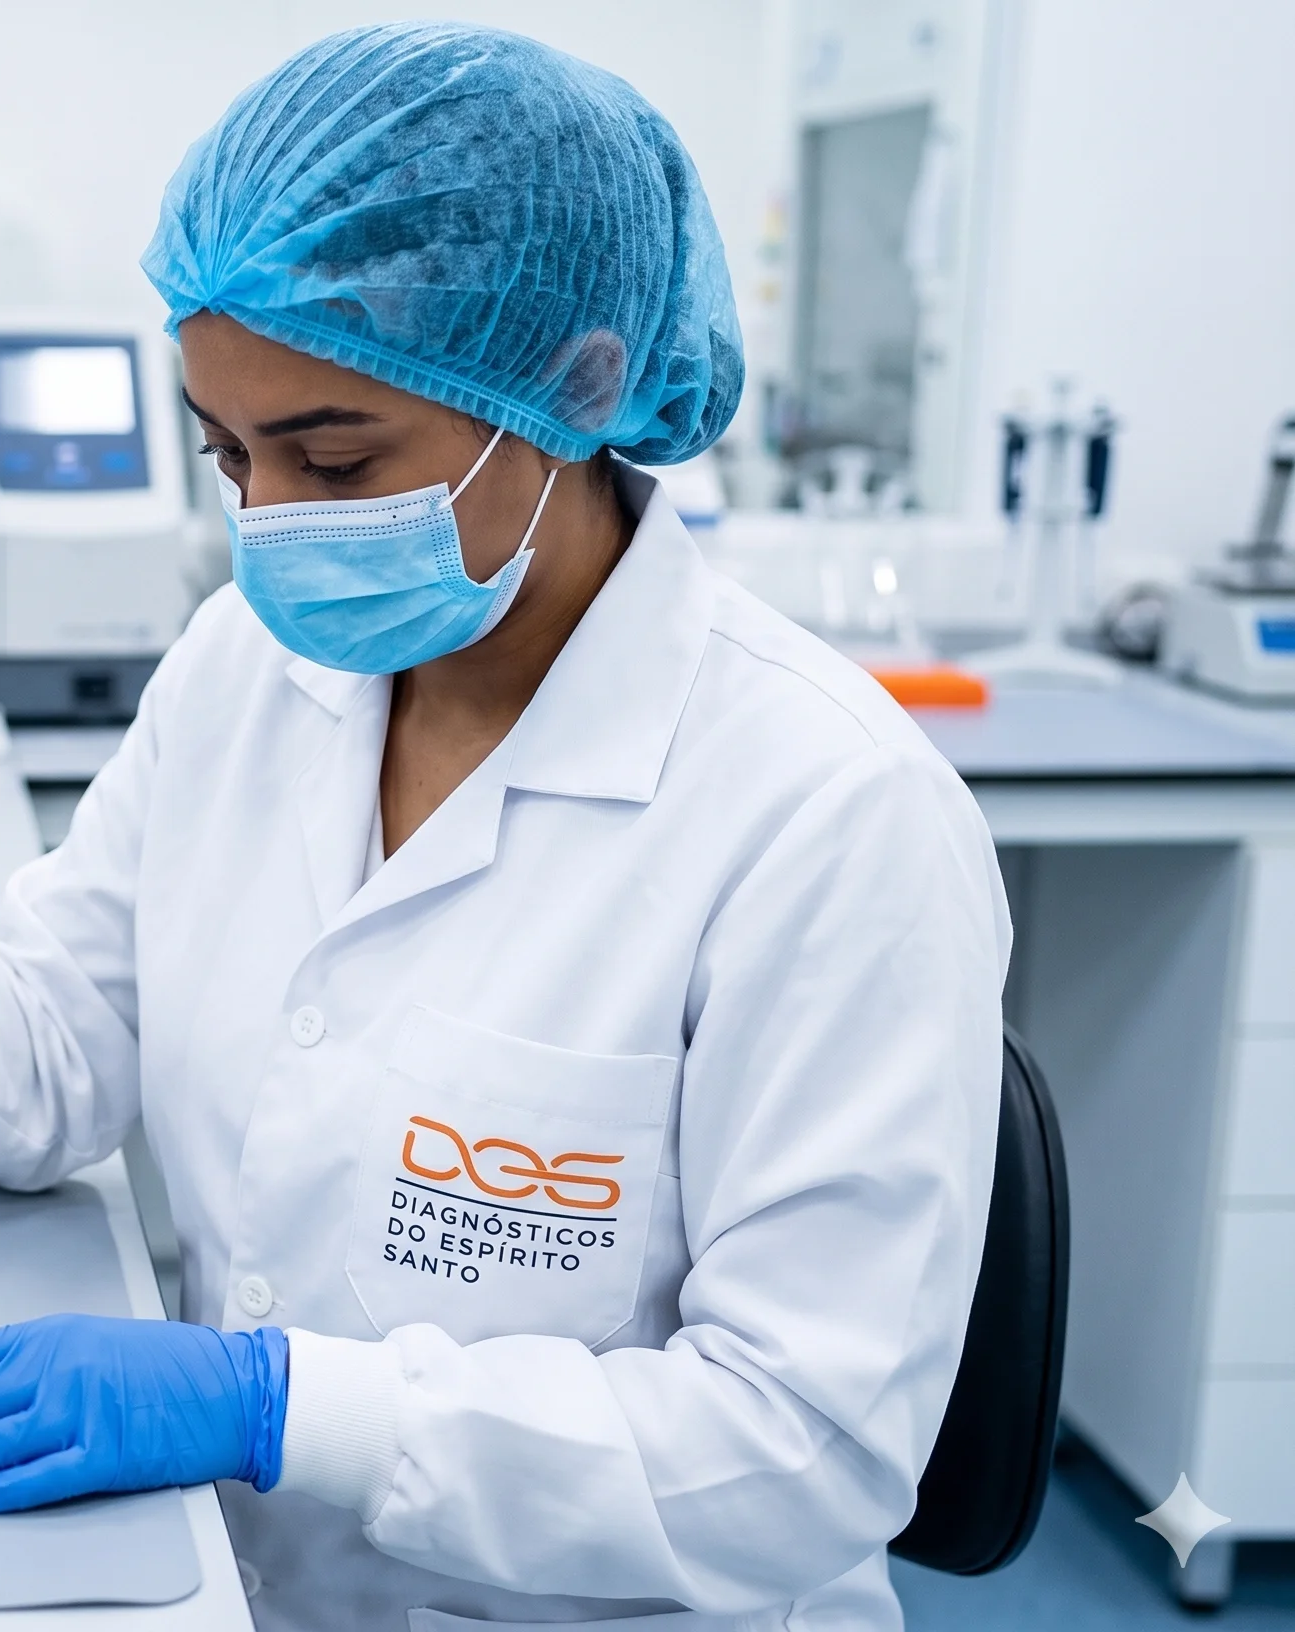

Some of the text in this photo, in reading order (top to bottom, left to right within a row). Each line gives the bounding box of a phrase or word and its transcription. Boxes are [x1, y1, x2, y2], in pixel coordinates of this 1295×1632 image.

[387, 1216, 581, 1272] DO ESPÍRITO
[391, 1190, 616, 1249] DIAGNÓSTICOS
[383, 1243, 481, 1284] SANTO
